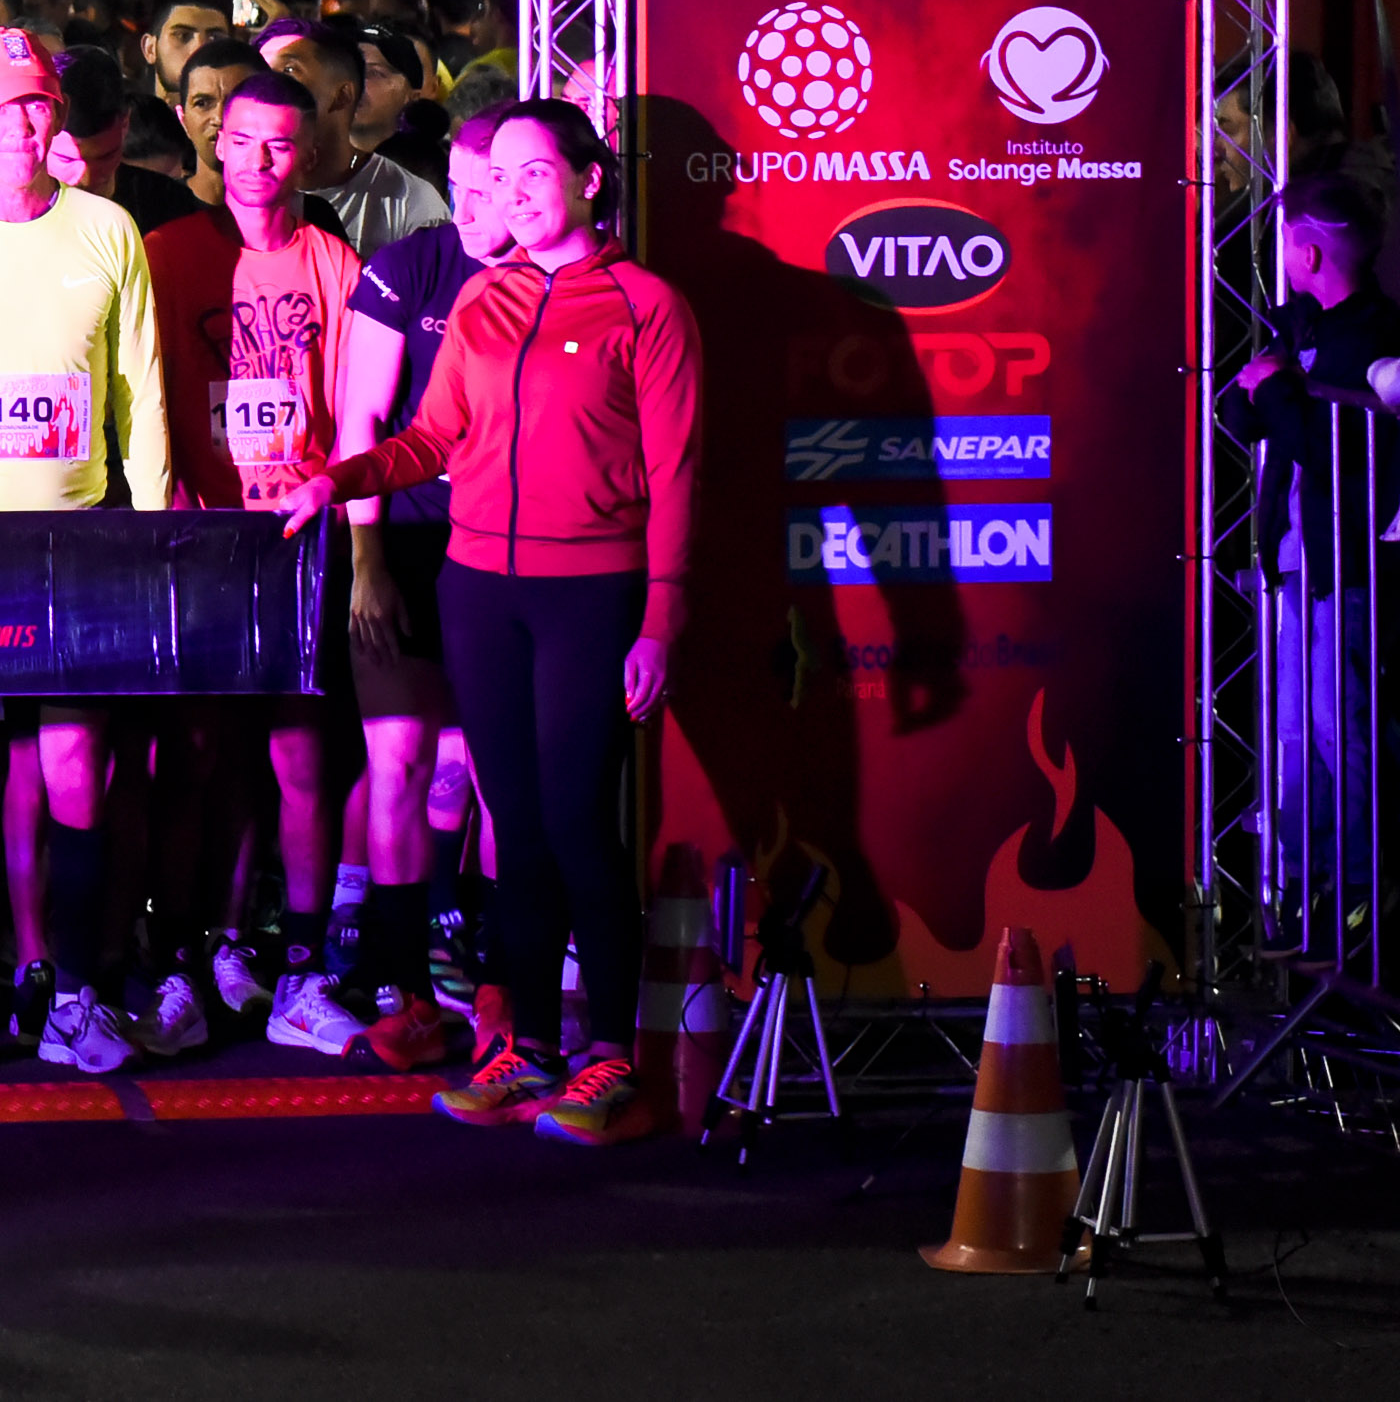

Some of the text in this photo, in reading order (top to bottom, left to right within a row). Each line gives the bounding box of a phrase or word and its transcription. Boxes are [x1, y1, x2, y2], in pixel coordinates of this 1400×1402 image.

[1007, 140, 1084, 156] Instituto
[686, 151, 930, 183] GRUPO MASSA
[948, 158, 1141, 186] Solange Massa
[878, 435, 1052, 461] SANEPAR
[788, 519, 1050, 570] DECATHLON
